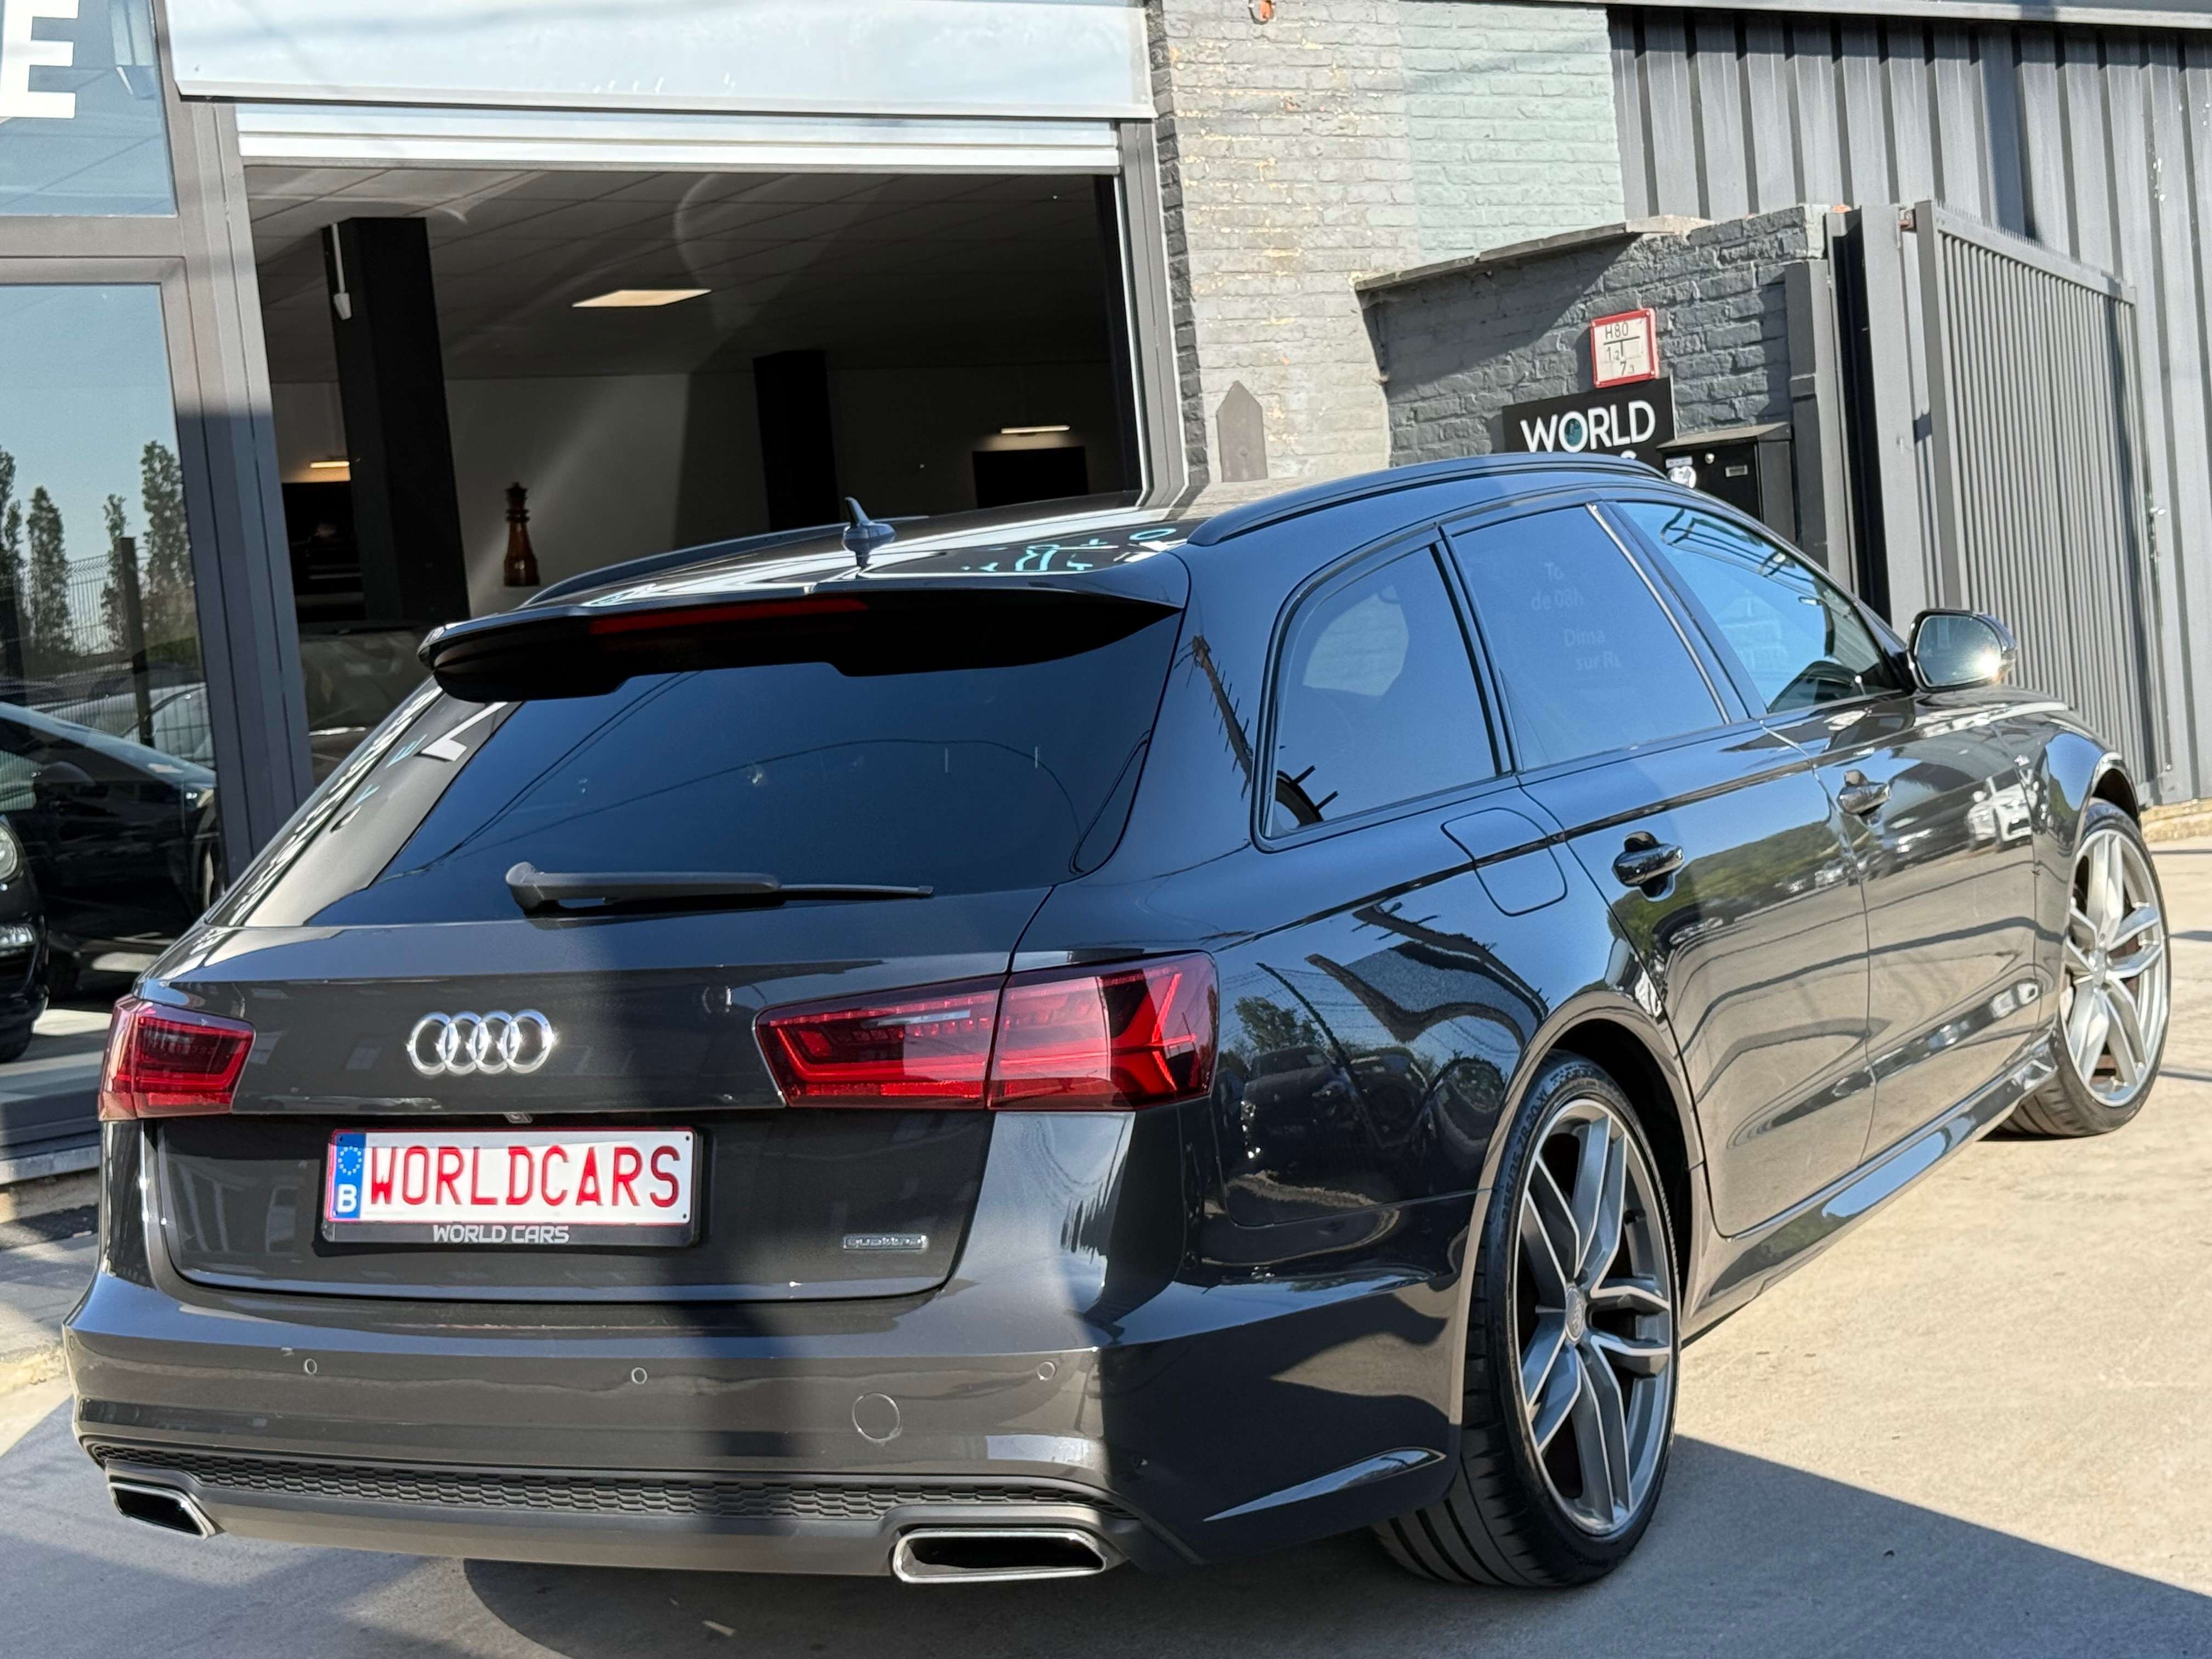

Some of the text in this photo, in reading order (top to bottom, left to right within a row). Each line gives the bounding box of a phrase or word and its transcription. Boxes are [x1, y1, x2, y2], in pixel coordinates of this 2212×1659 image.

[0, 0, 80, 119] E
[1605, 322, 1629, 340] H80
[1520, 400, 1655, 453] WORLD
[337, 1145, 681, 1213] B WORLDCARS
[433, 1225, 569, 1244] WORLD CARS
